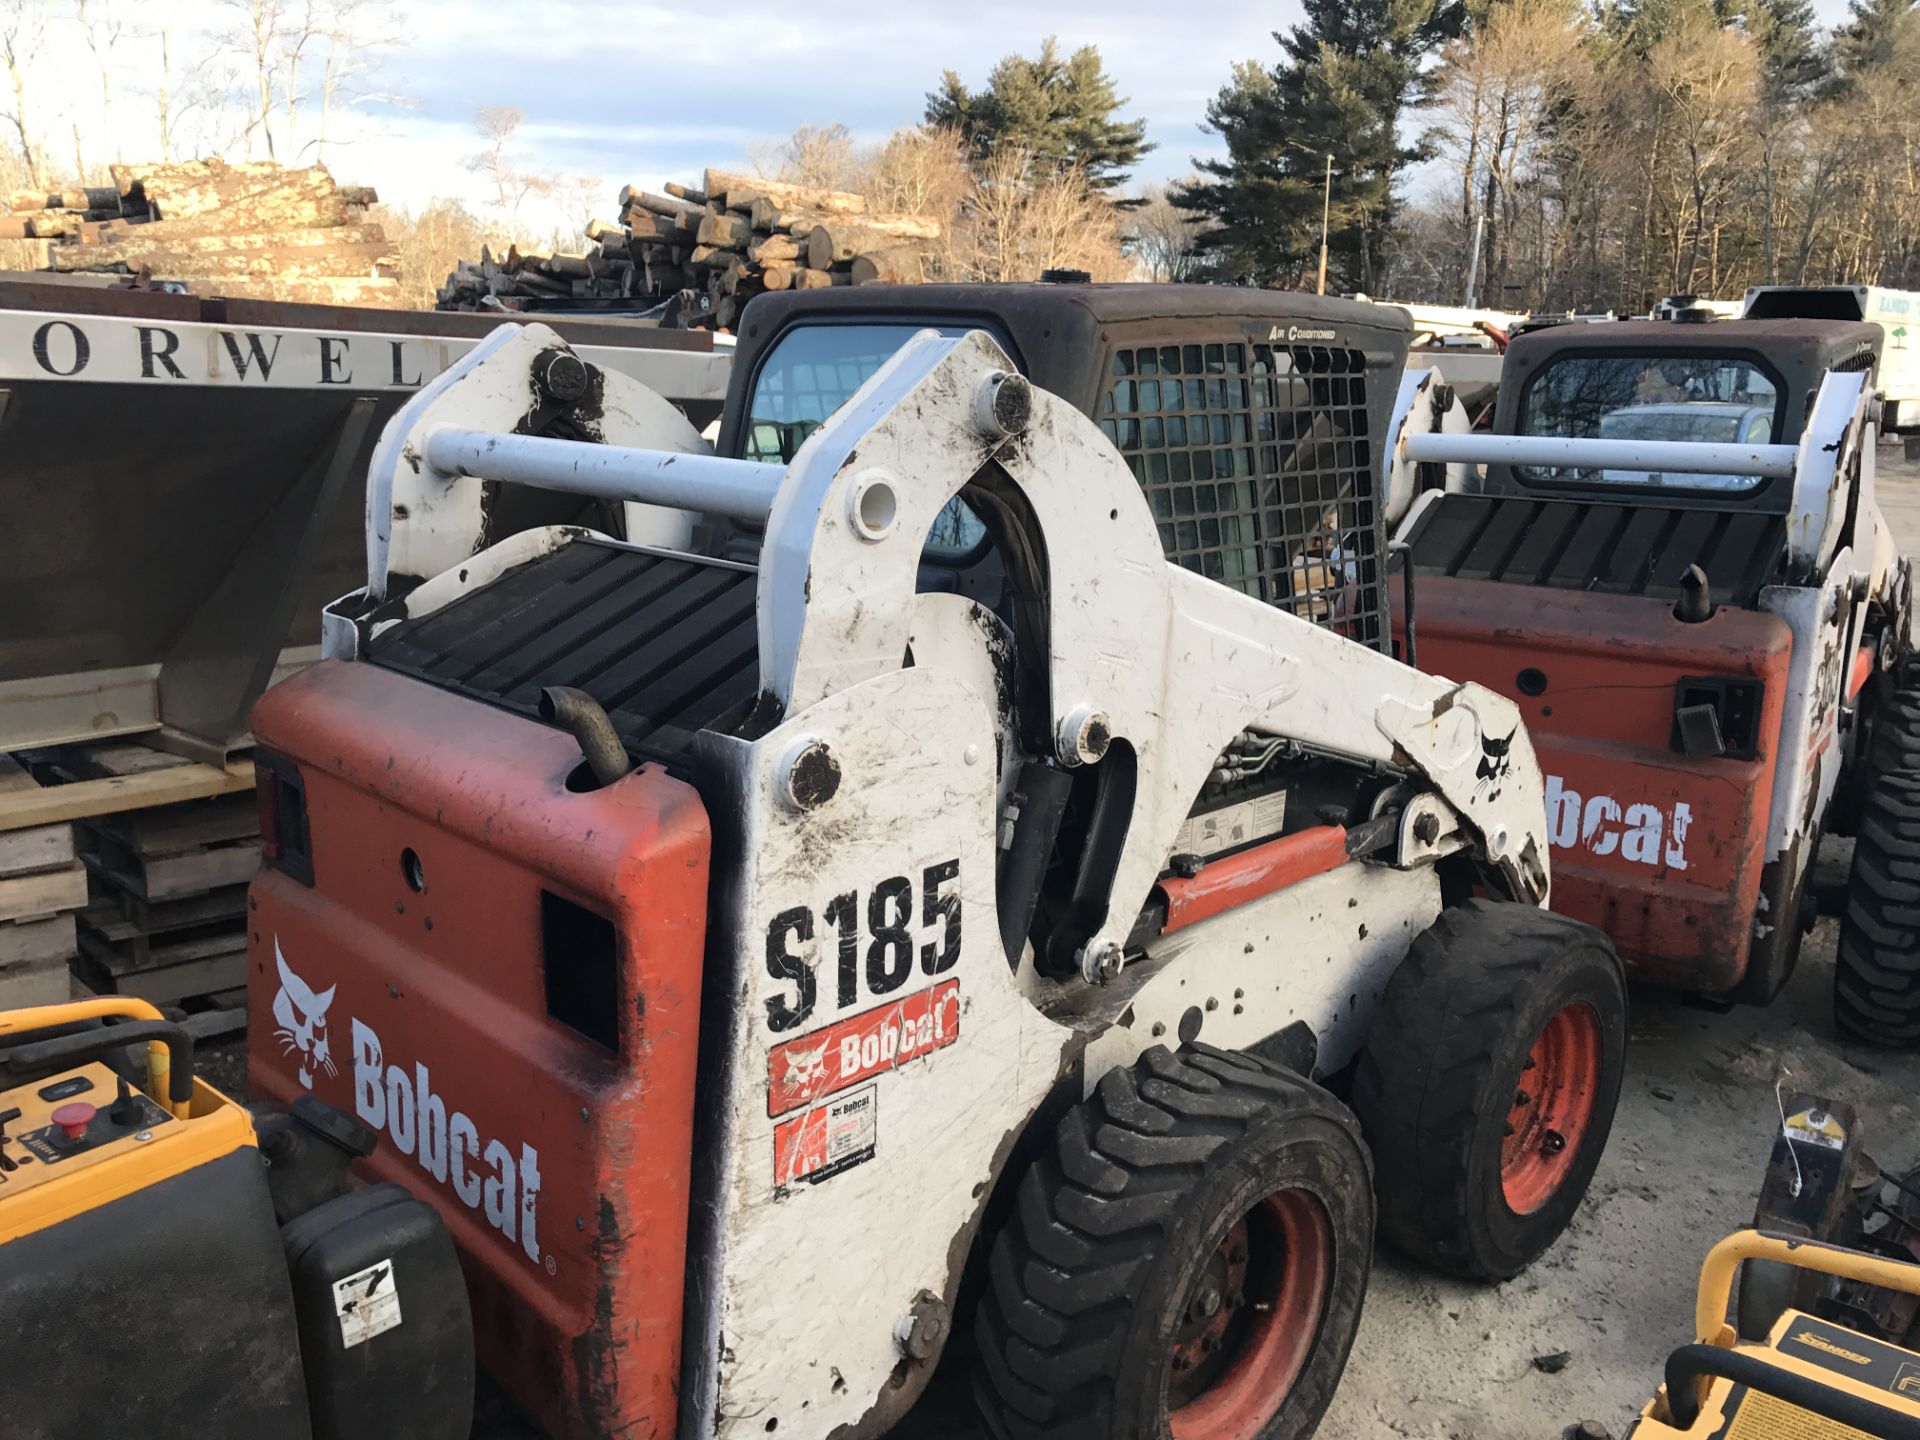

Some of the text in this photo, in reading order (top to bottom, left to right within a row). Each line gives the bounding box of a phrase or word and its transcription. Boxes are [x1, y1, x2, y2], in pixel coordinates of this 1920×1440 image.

[764, 859, 962, 1033] S185
[840, 1001, 947, 1080] Bobcat
[352, 1016, 541, 1264] Bobcat
[843, 1096, 869, 1114] Bobcat
